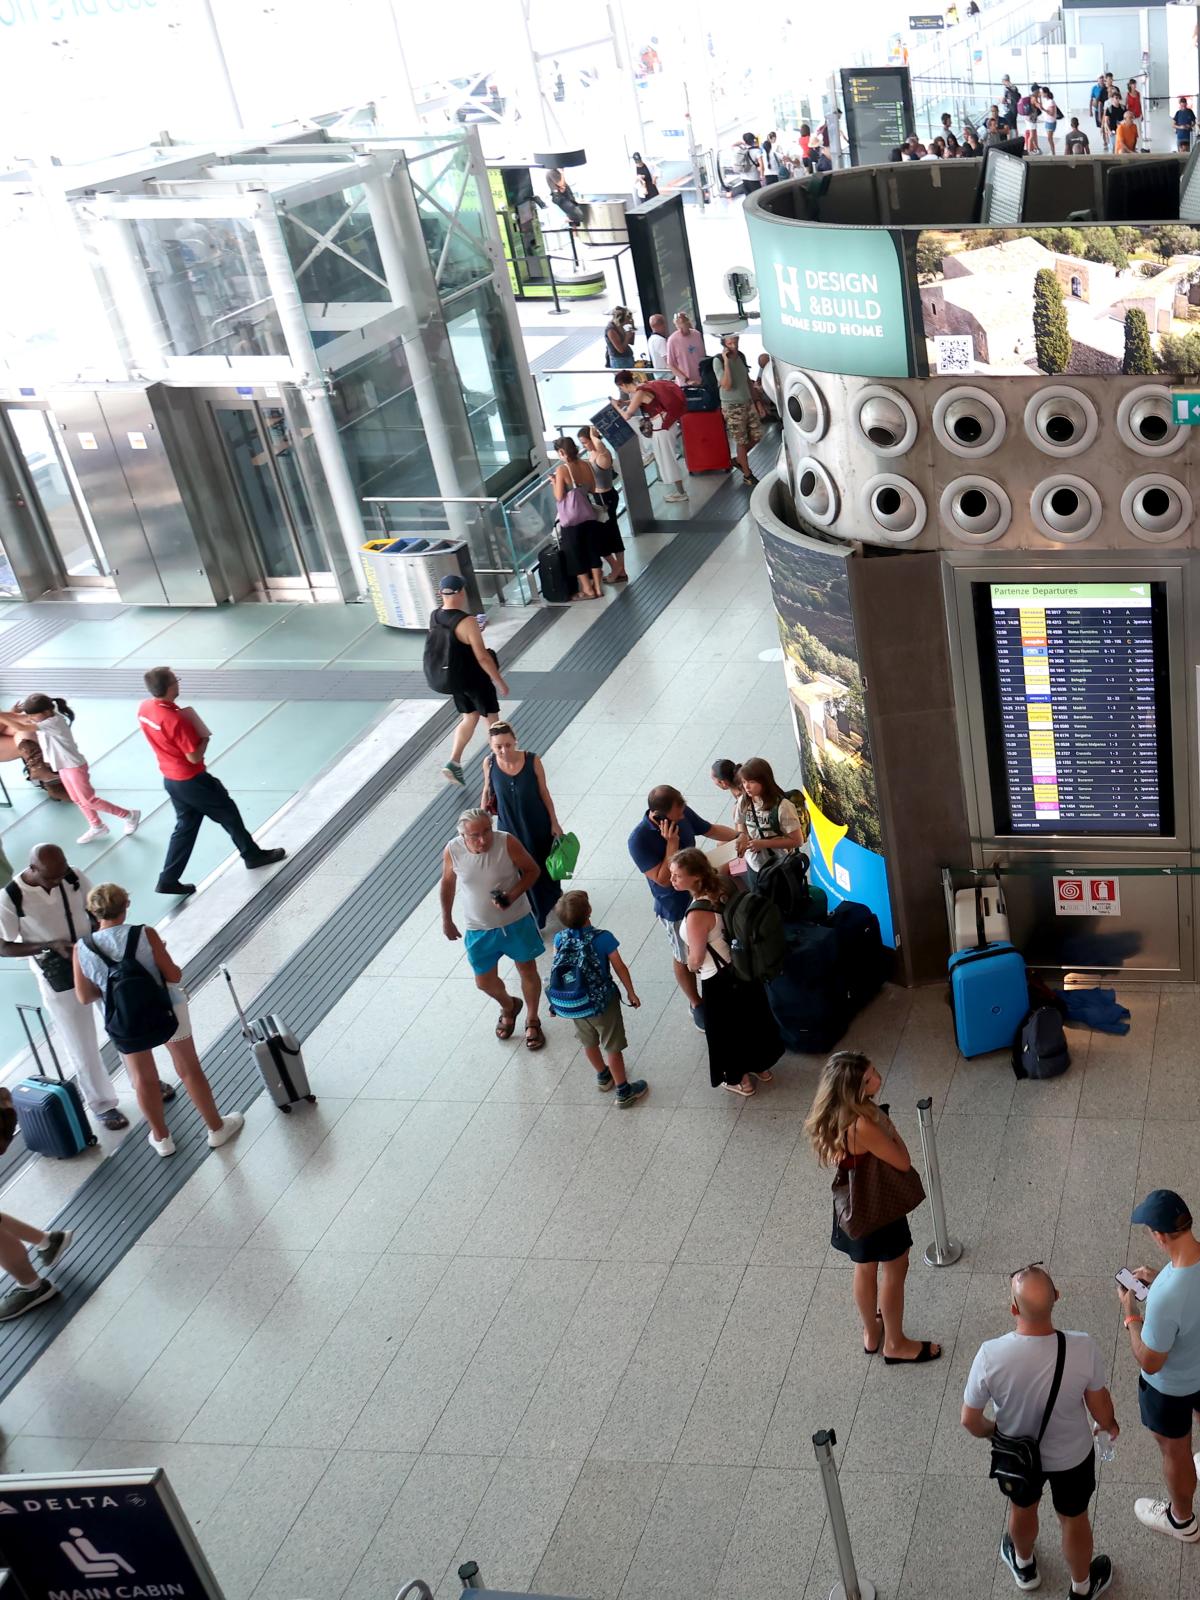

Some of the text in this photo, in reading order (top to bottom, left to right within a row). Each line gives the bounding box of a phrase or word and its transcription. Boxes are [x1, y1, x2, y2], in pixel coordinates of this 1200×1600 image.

[805, 270, 878, 294] DESIGN
[810, 296, 881, 320] &BUILD
[781, 313, 883, 338] HOME SUD HOME
[1033, 587, 1078, 595] Departures
[23, 1495, 119, 1512] DELTA
[47, 1583, 185, 1600] MAIN CABIN
